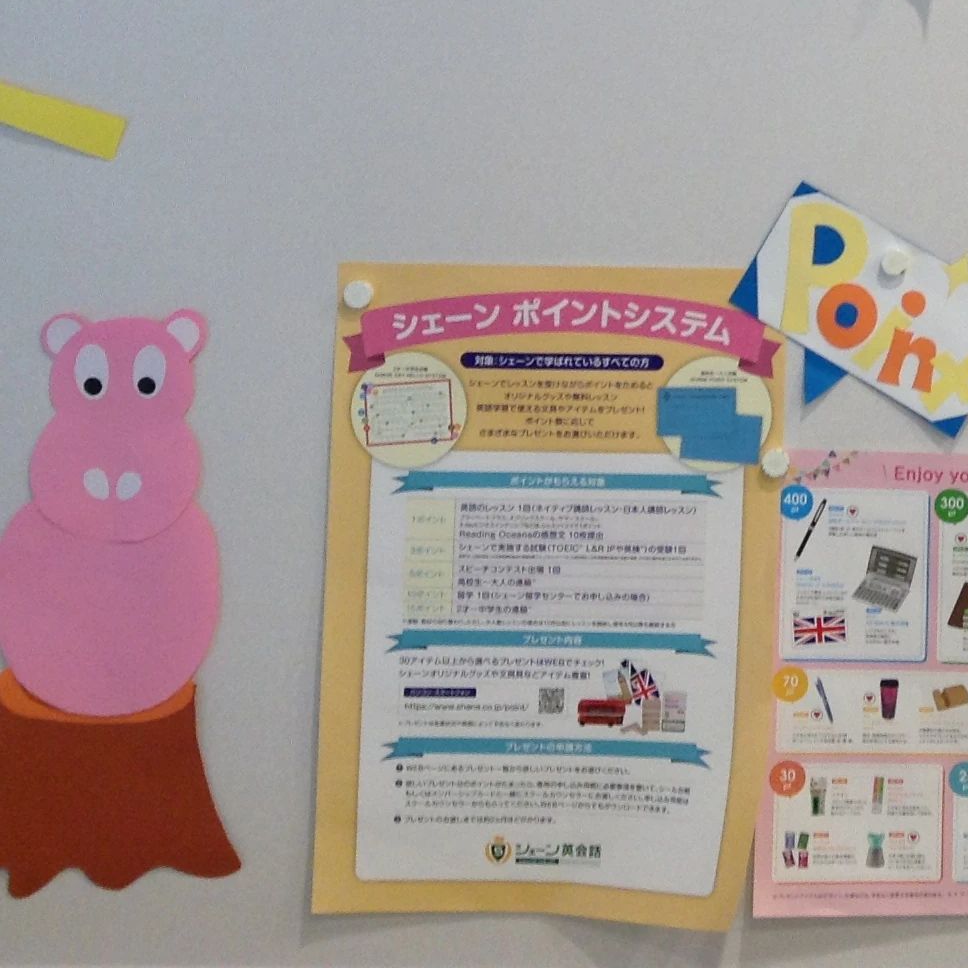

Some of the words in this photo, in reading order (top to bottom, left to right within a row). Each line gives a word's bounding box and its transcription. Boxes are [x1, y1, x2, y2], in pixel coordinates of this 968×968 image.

[391, 302, 501, 341] シェーン
[511, 298, 733, 345] ポイントシステム
[894, 465, 945, 484] Enjoy
[784, 493, 808, 506] 400
[940, 498, 964, 510] 300
[783, 676, 799, 688] 70
[779, 770, 797, 781] 30
